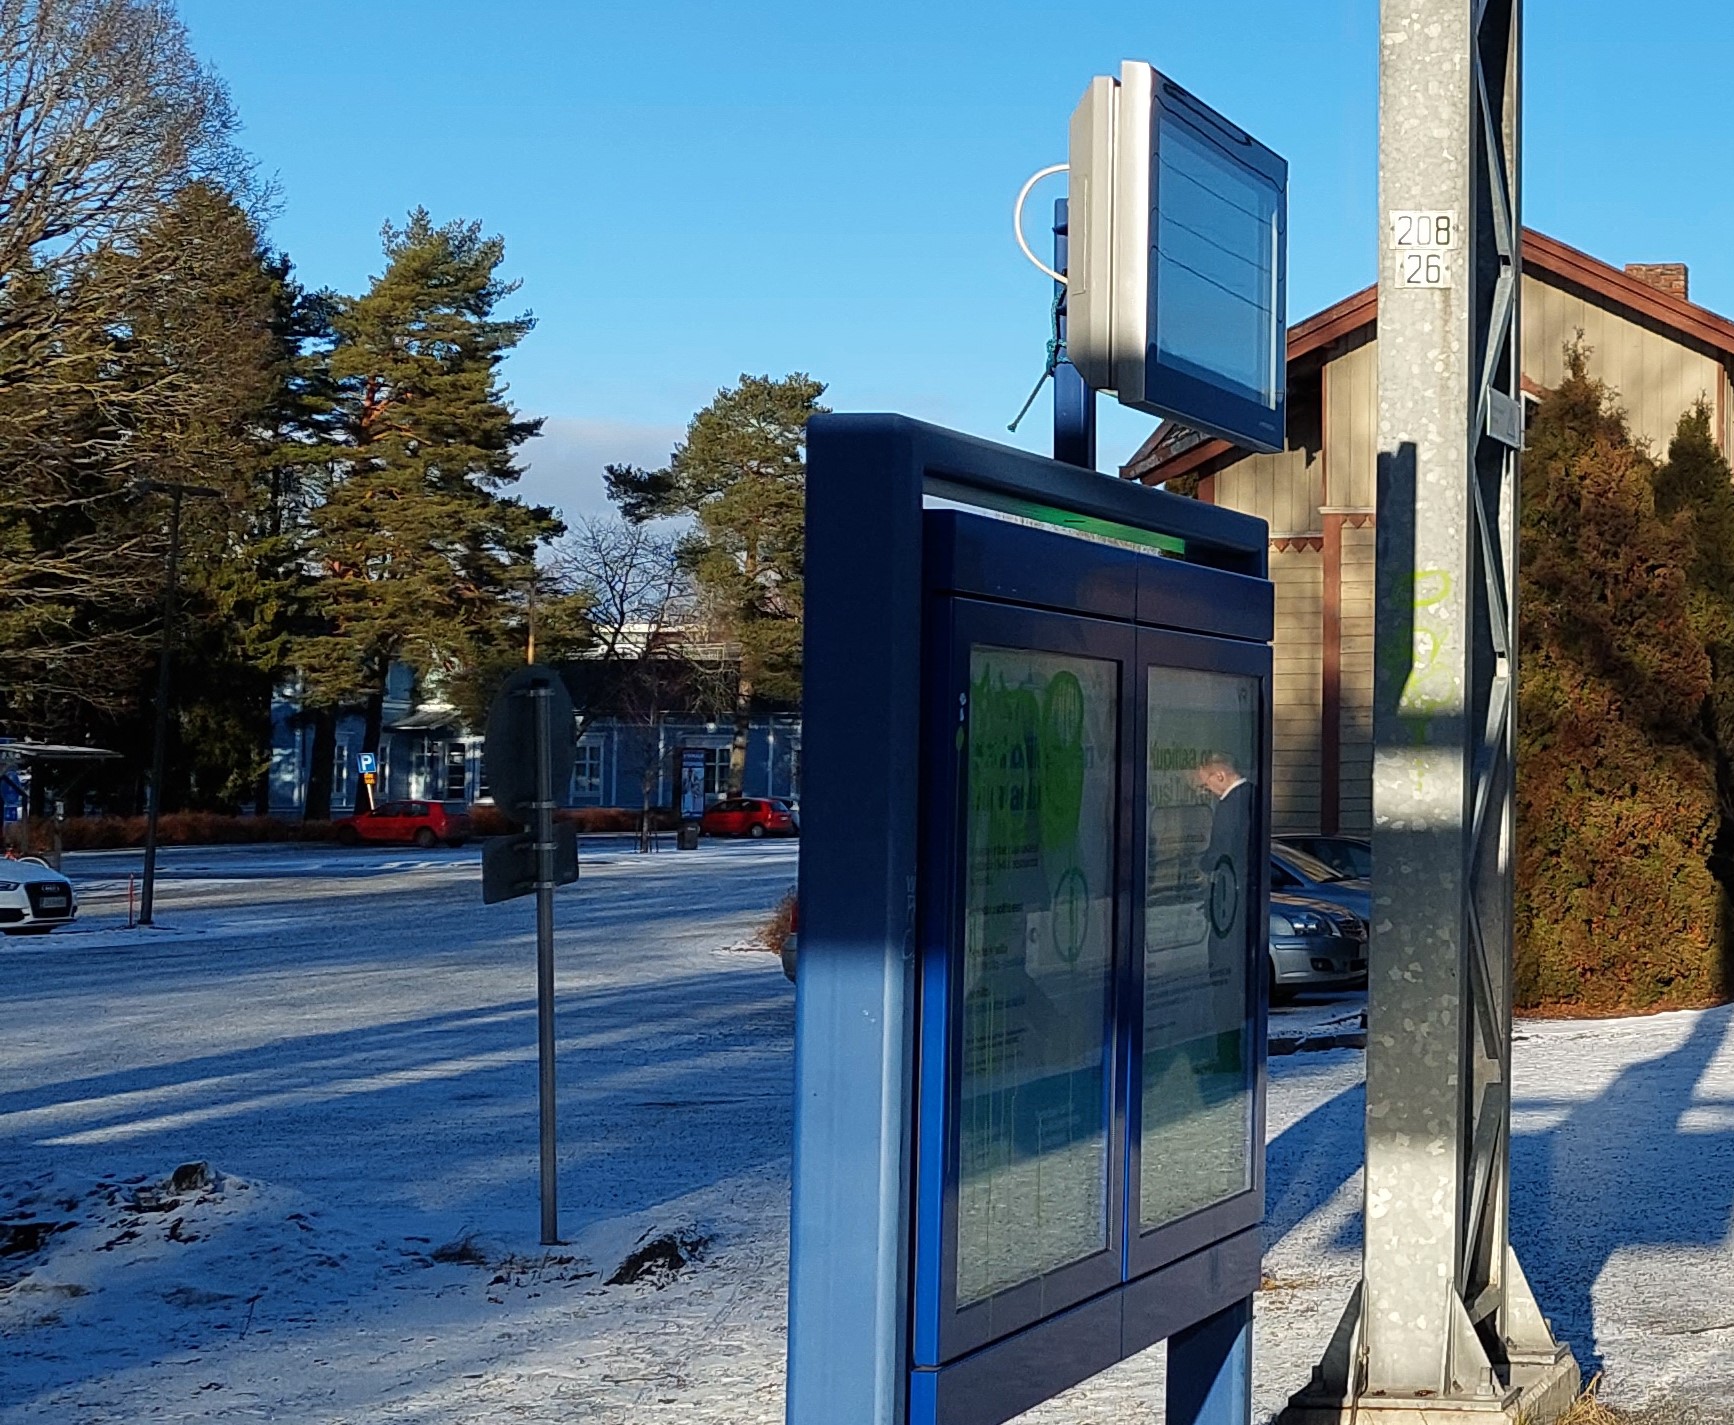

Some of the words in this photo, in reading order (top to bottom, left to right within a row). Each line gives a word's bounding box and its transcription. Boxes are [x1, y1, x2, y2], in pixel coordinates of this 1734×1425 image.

[1398, 215, 1451, 246] 208
[1406, 253, 1441, 284] 26
[361, 754, 373, 771] P
